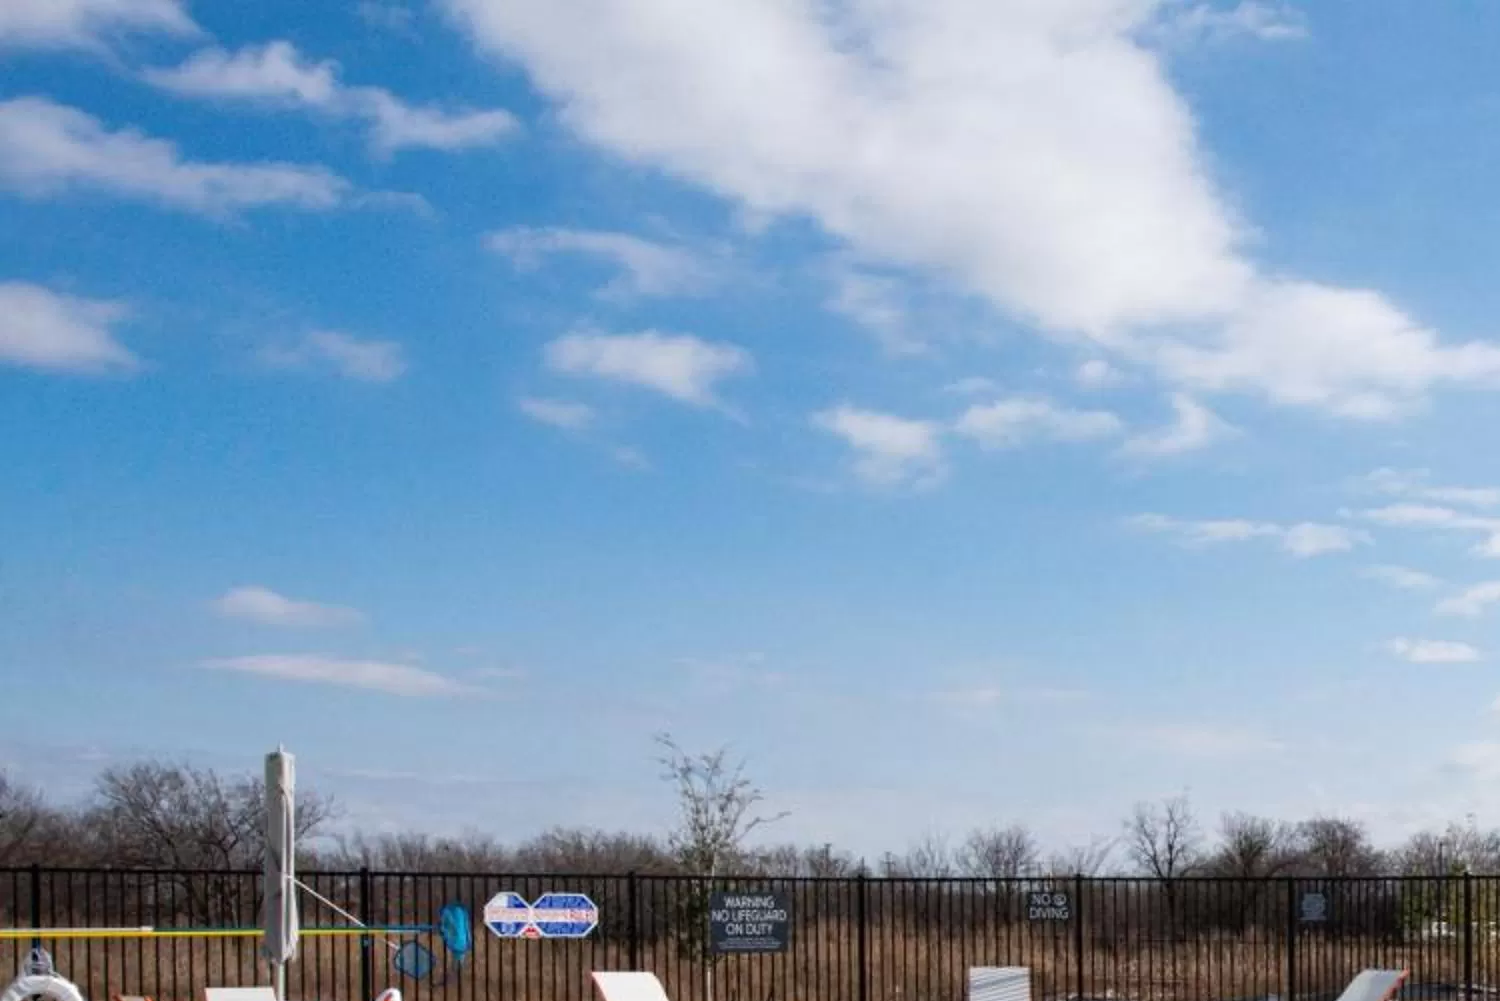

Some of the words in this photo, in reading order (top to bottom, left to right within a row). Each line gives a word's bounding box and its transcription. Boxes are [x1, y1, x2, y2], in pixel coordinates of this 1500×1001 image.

[723, 895, 775, 909] WARNING
[1031, 893, 1051, 906] NO
[711, 909, 730, 922] NO
[732, 909, 787, 922] LIFEGUARD
[1029, 907, 1069, 919] DIVING
[725, 922, 743, 935] ON
[745, 922, 773, 935] DUTY
